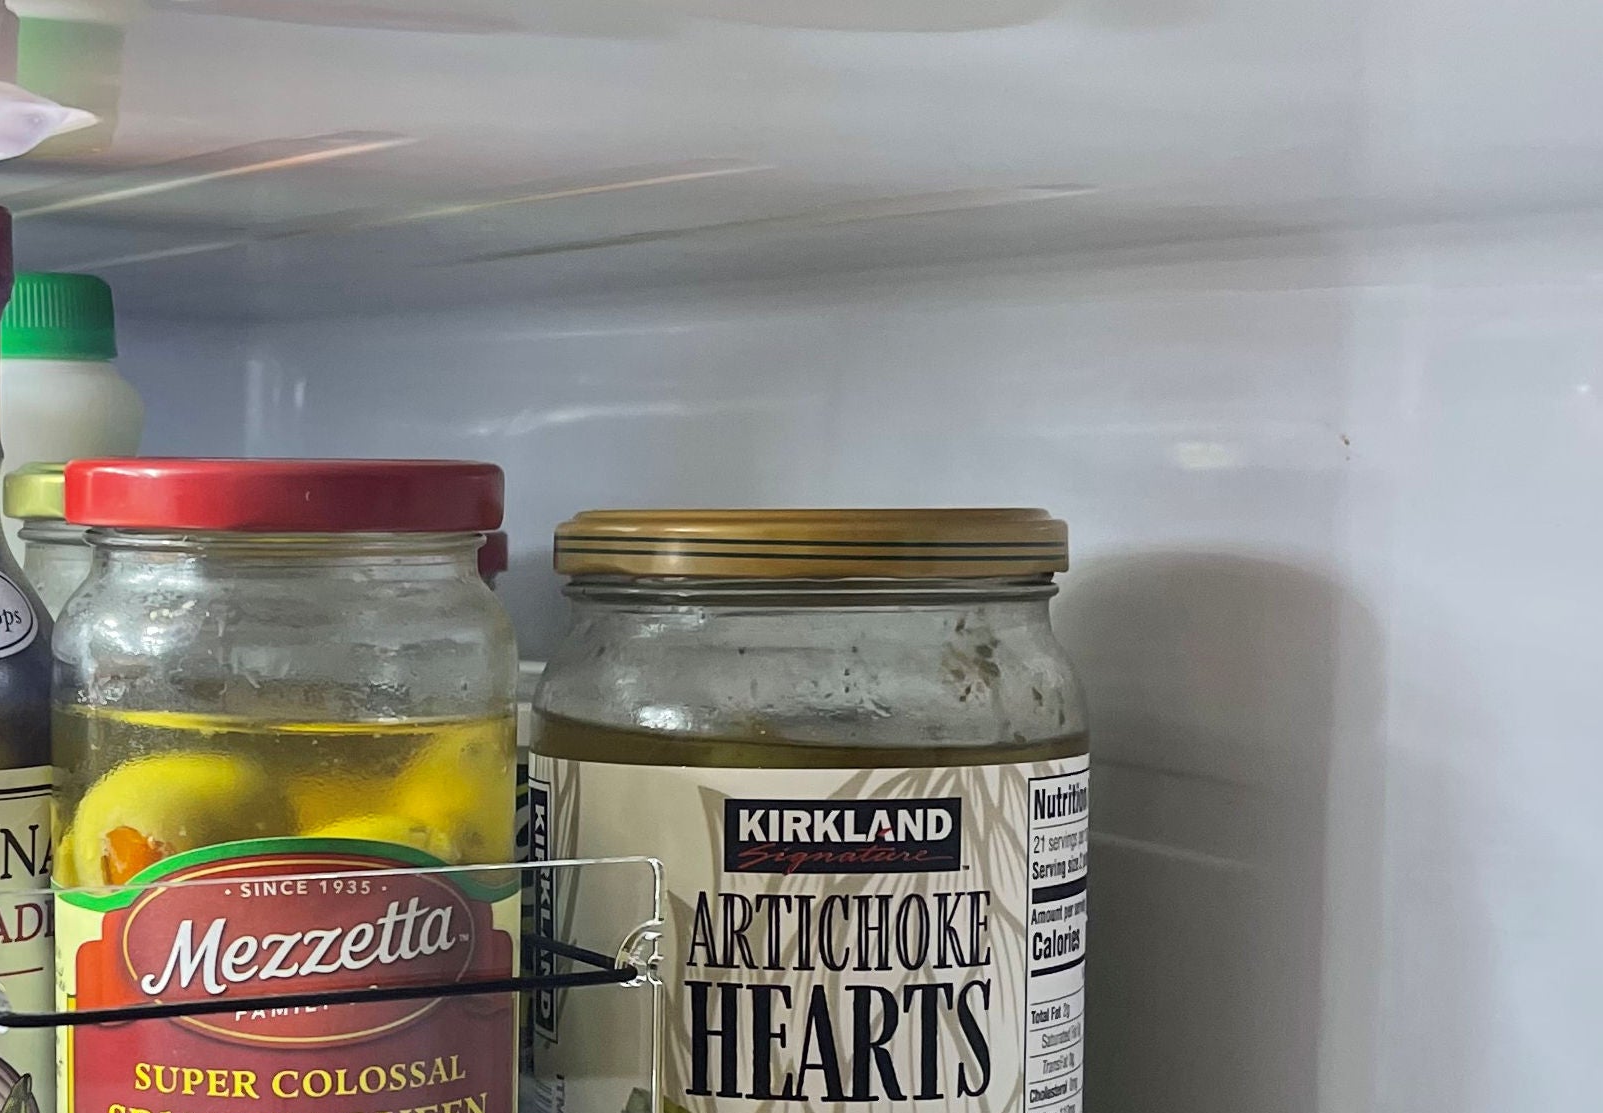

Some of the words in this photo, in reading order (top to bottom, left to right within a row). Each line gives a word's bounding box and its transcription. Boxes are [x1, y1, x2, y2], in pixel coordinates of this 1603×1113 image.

[738, 808, 953, 842] KIRKLAND
[738, 840, 954, 876] Signature
[1033, 835, 1046, 854] 21
[1032, 858, 1066, 881] Serving
[239, 879, 308, 898] SINCE
[320, 879, 372, 895] 1935
[141, 896, 456, 996] Mezzetta
[686, 889, 992, 972] ARTICHOKE
[1032, 925, 1081, 962] Calories
[1031, 1008, 1050, 1025] Total
[1050, 1005, 1062, 1020] Fat
[684, 978, 991, 1101] HEARTS
[135, 1061, 262, 1099] SUPER
[272, 1055, 466, 1099] COLOSSAL
